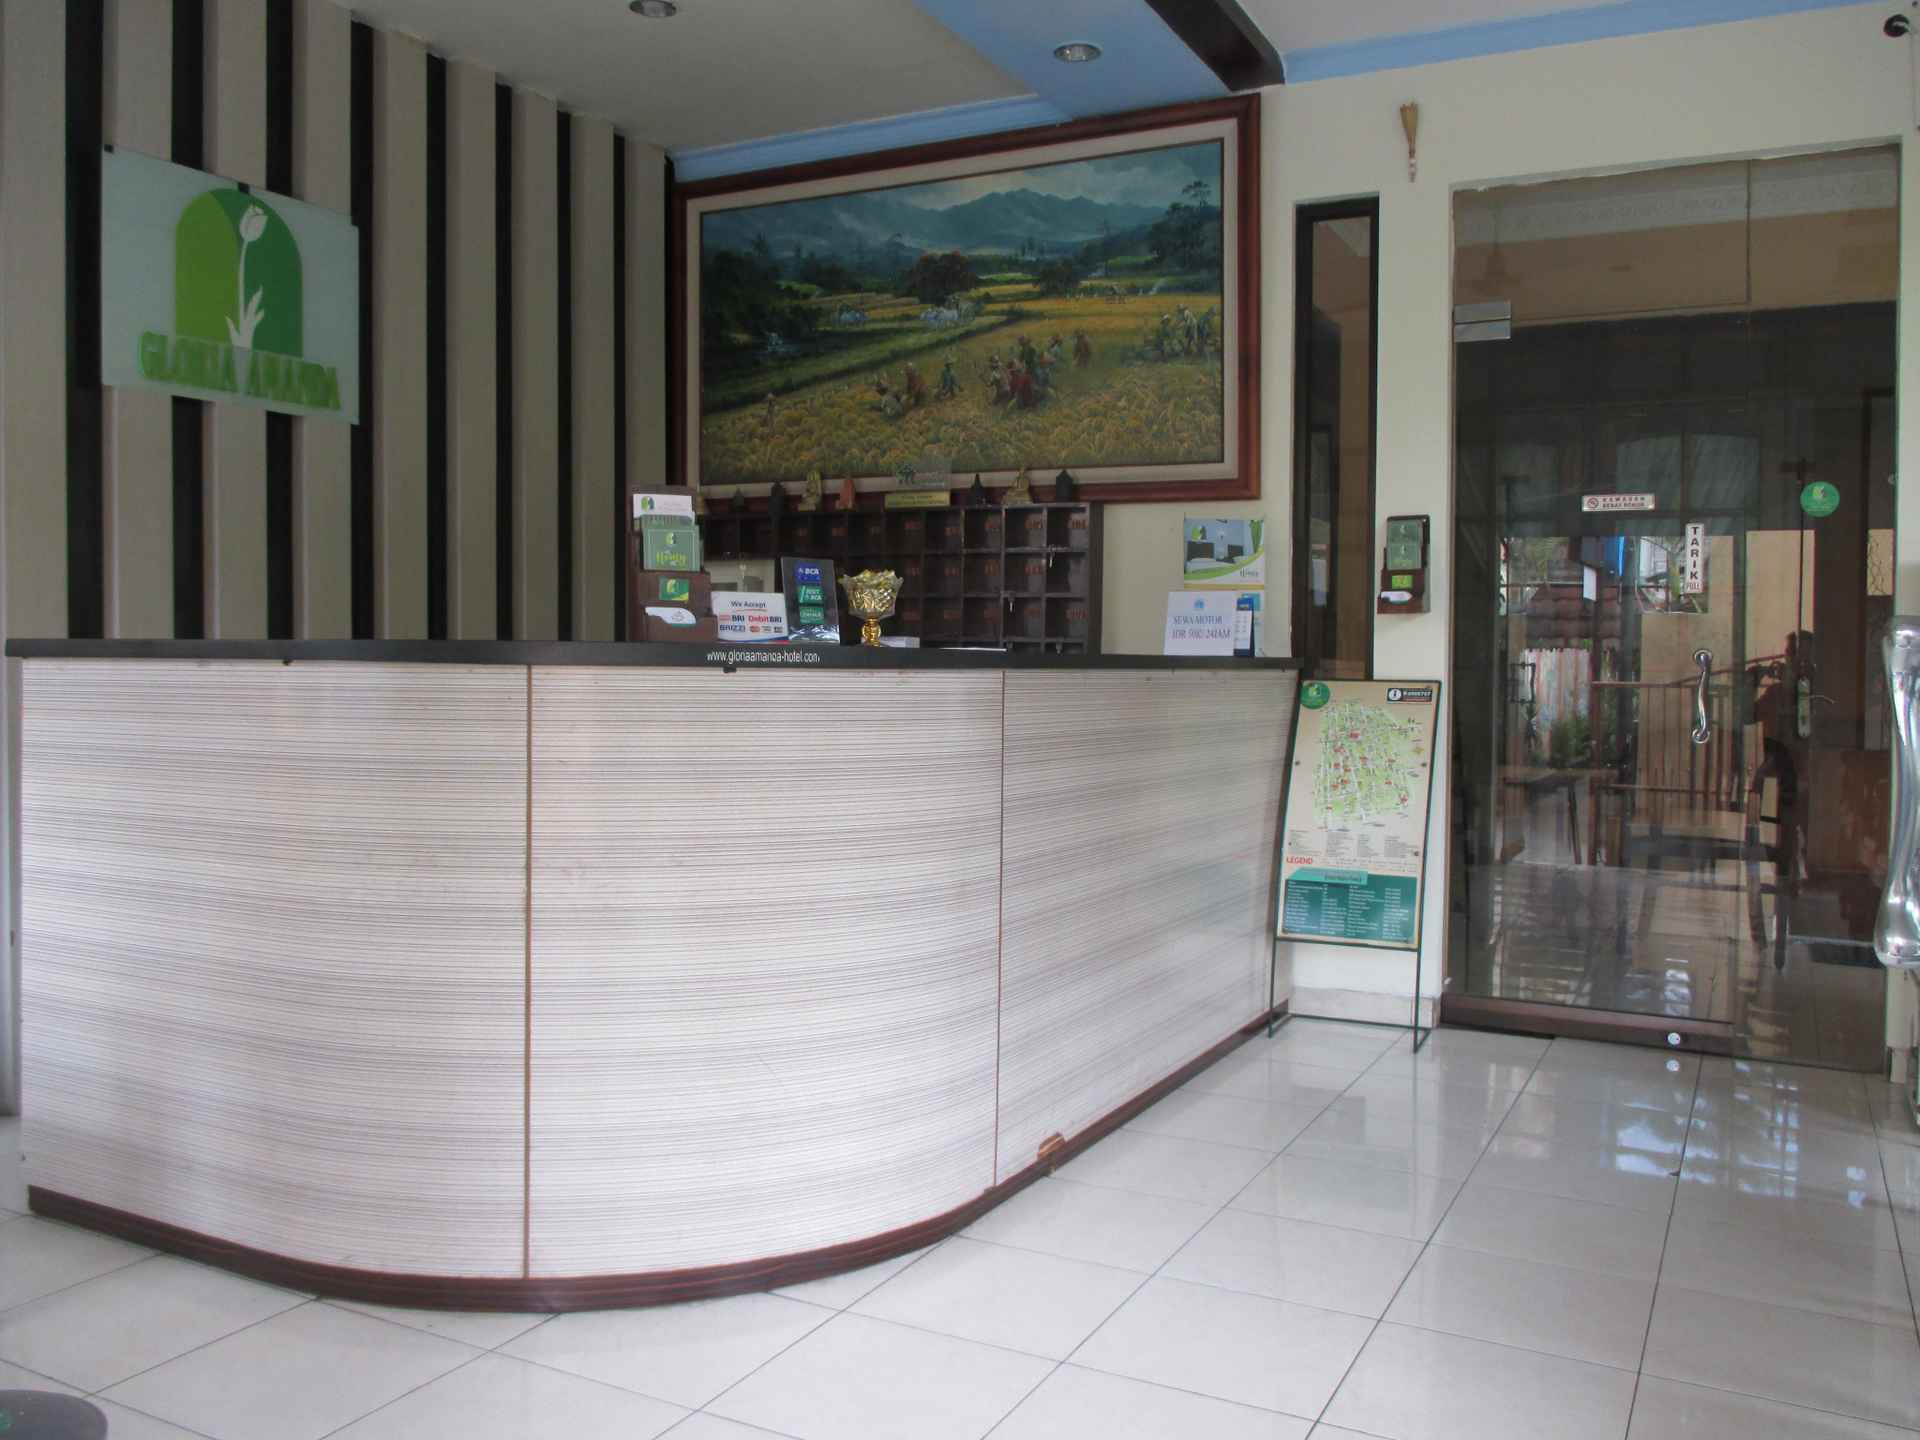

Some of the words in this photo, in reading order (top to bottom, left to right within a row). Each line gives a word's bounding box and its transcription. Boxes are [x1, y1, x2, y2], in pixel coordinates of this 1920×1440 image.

[1689, 526, 1700, 580] TARIK
[732, 614, 745, 622] BRI
[1286, 856, 1314, 865] LEGEND
